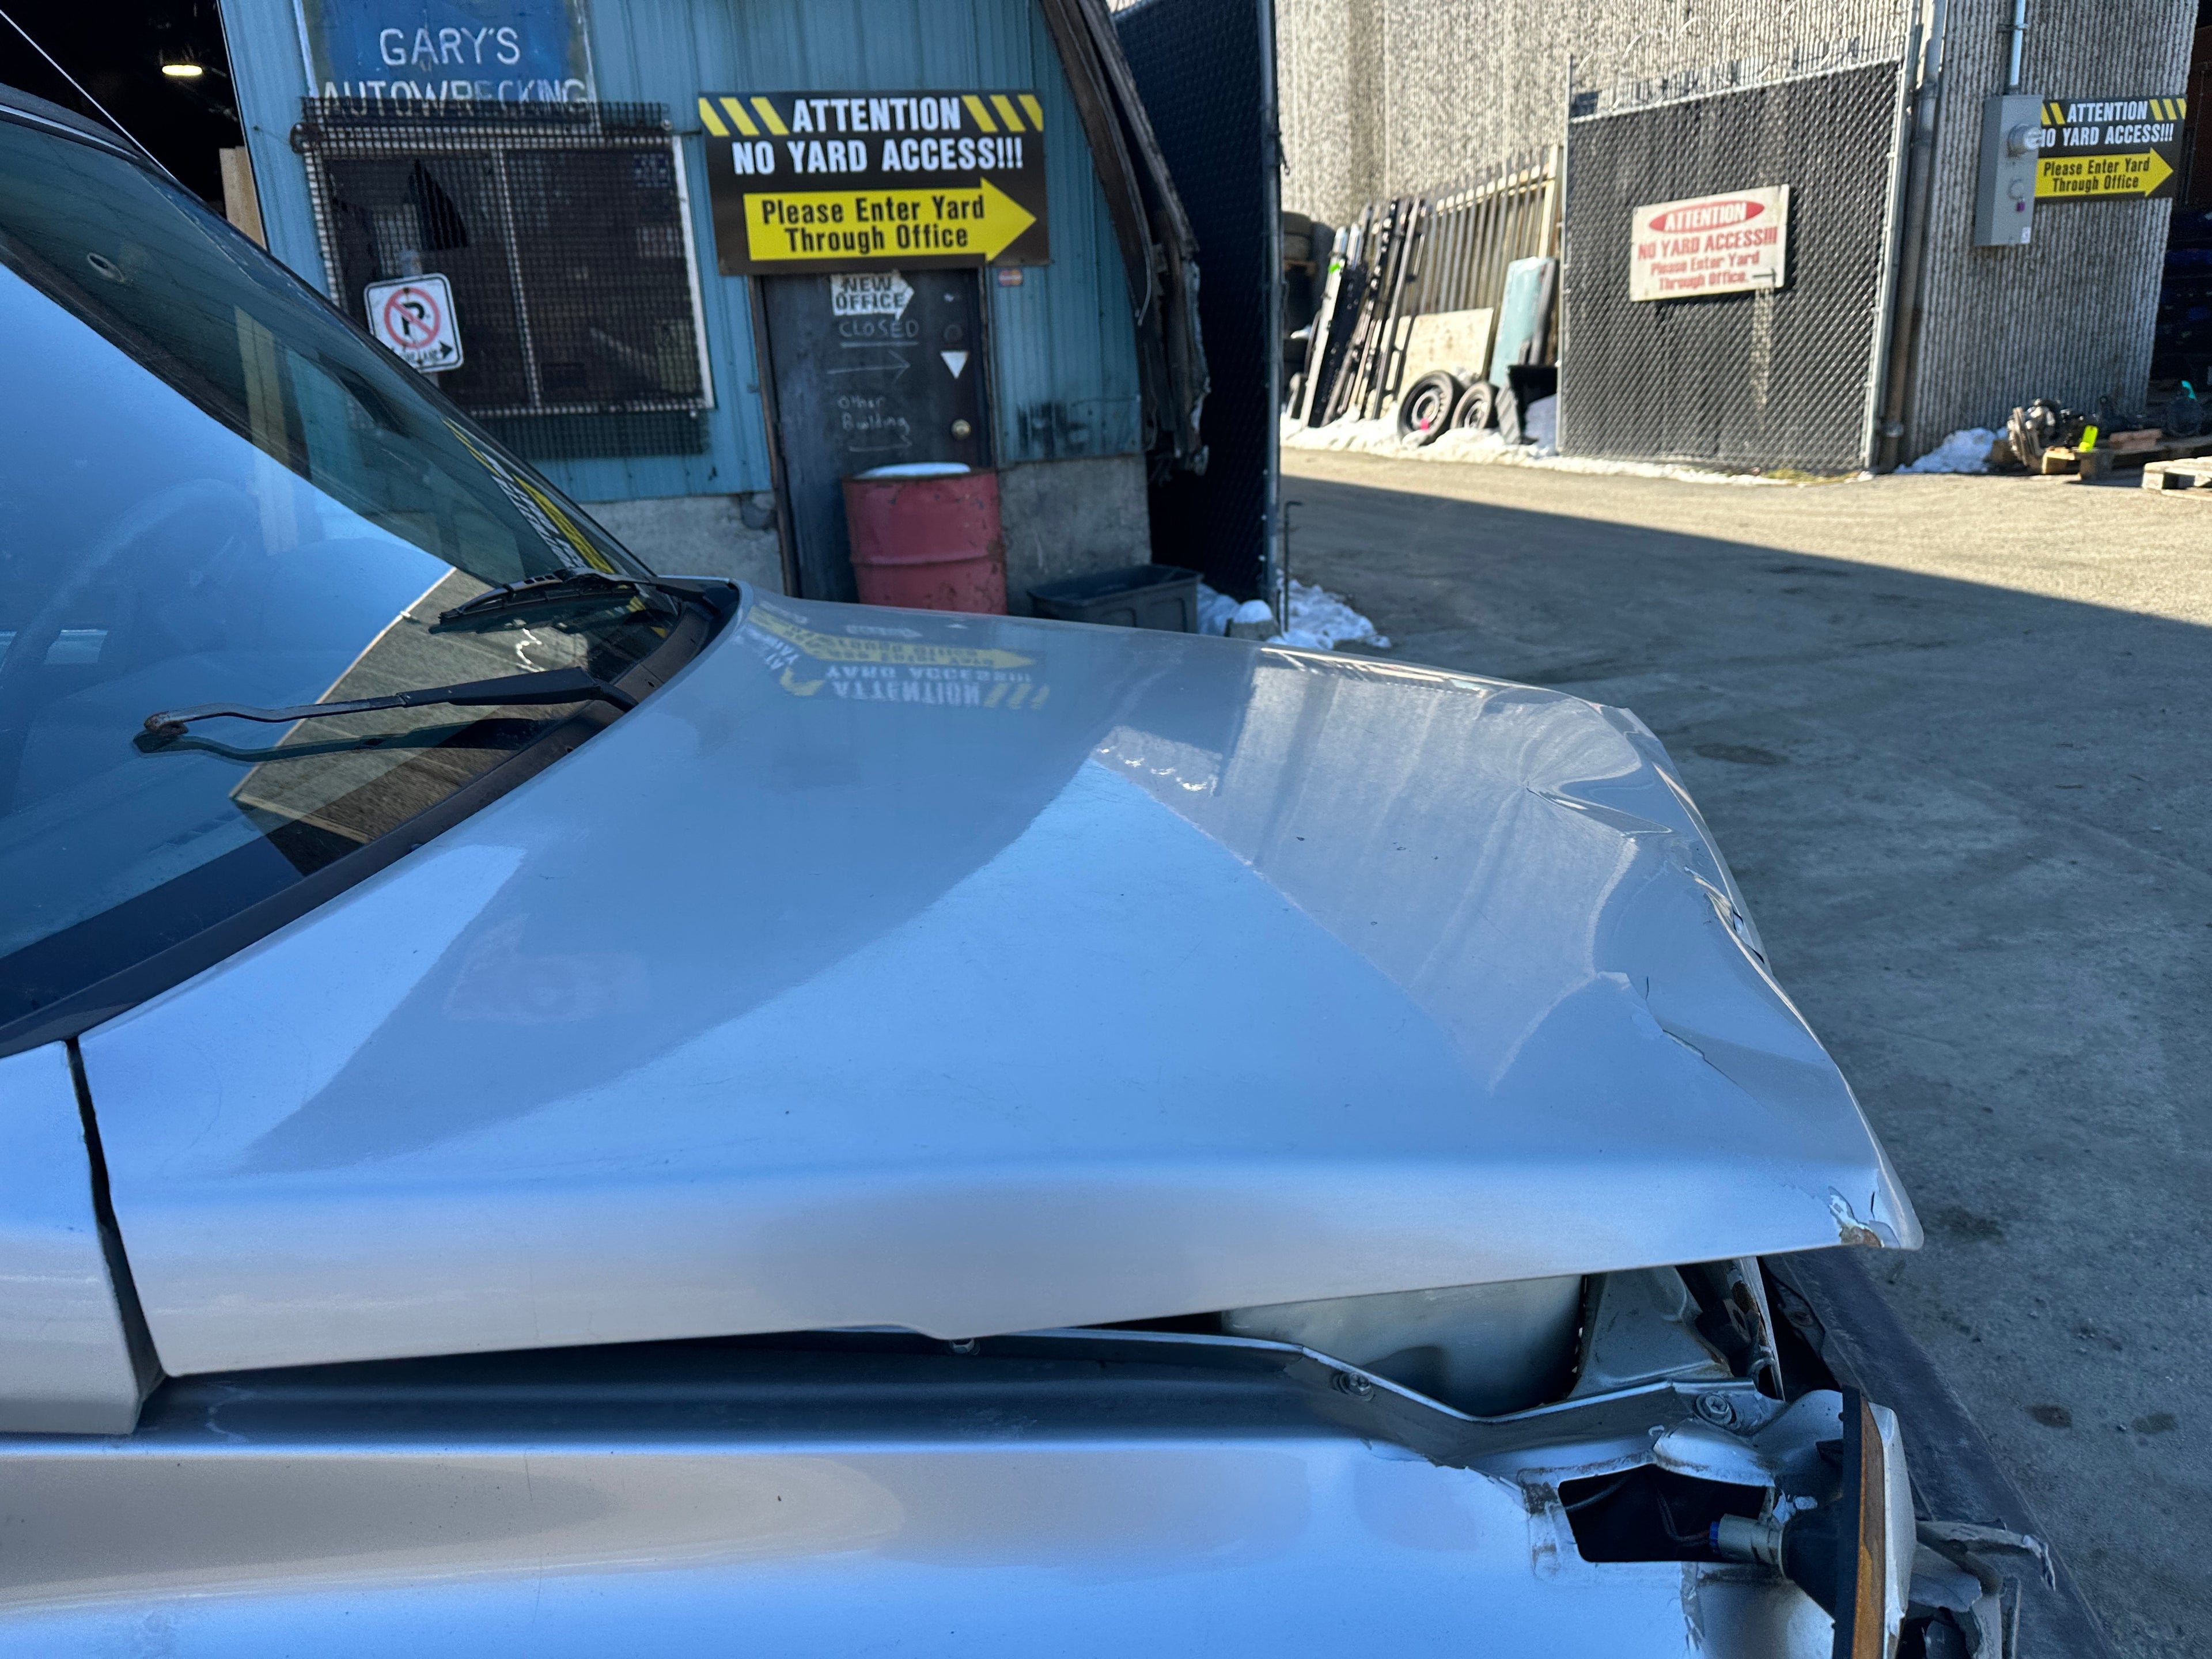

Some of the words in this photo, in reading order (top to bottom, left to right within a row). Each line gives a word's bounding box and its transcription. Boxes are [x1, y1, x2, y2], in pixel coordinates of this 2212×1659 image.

[380, 26, 521, 66] GARY'S
[323, 79, 588, 117] AUTOWRECKING
[792, 97, 961, 133] ATTENTION
[2066, 101, 2148, 123] ATTENTION
[2062, 126, 2100, 147] YARD
[2104, 123, 2175, 145] ACCESS!!!
[732, 141, 775, 175] NO
[787, 139, 867, 173] YARD
[881, 137, 1024, 171] ACCESS!!!
[2043, 161, 2082, 176] Please
[2087, 160, 2120, 175] Enter
[2124, 157, 2150, 172] Yard
[2052, 177, 2099, 194] Through
[2104, 175, 2139, 189] Office
[762, 199, 844, 225] Please
[855, 197, 920, 222] Enter
[932, 195, 985, 220] Yard
[1664, 202, 1747, 230] ATTENTION
[784, 227, 885, 255] Through
[896, 224, 969, 249] Office
[1638, 241, 1656, 260] NO
[1661, 236, 1700, 258] YARD
[1704, 226, 1778, 252] ACCESS!!!
[1691, 256, 1725, 271] Enter
[1728, 250, 1760, 267] Yard
[843, 275, 892, 293] NEW
[835, 291, 904, 311] OFFICE
[839, 318, 920, 338] CLOSED
